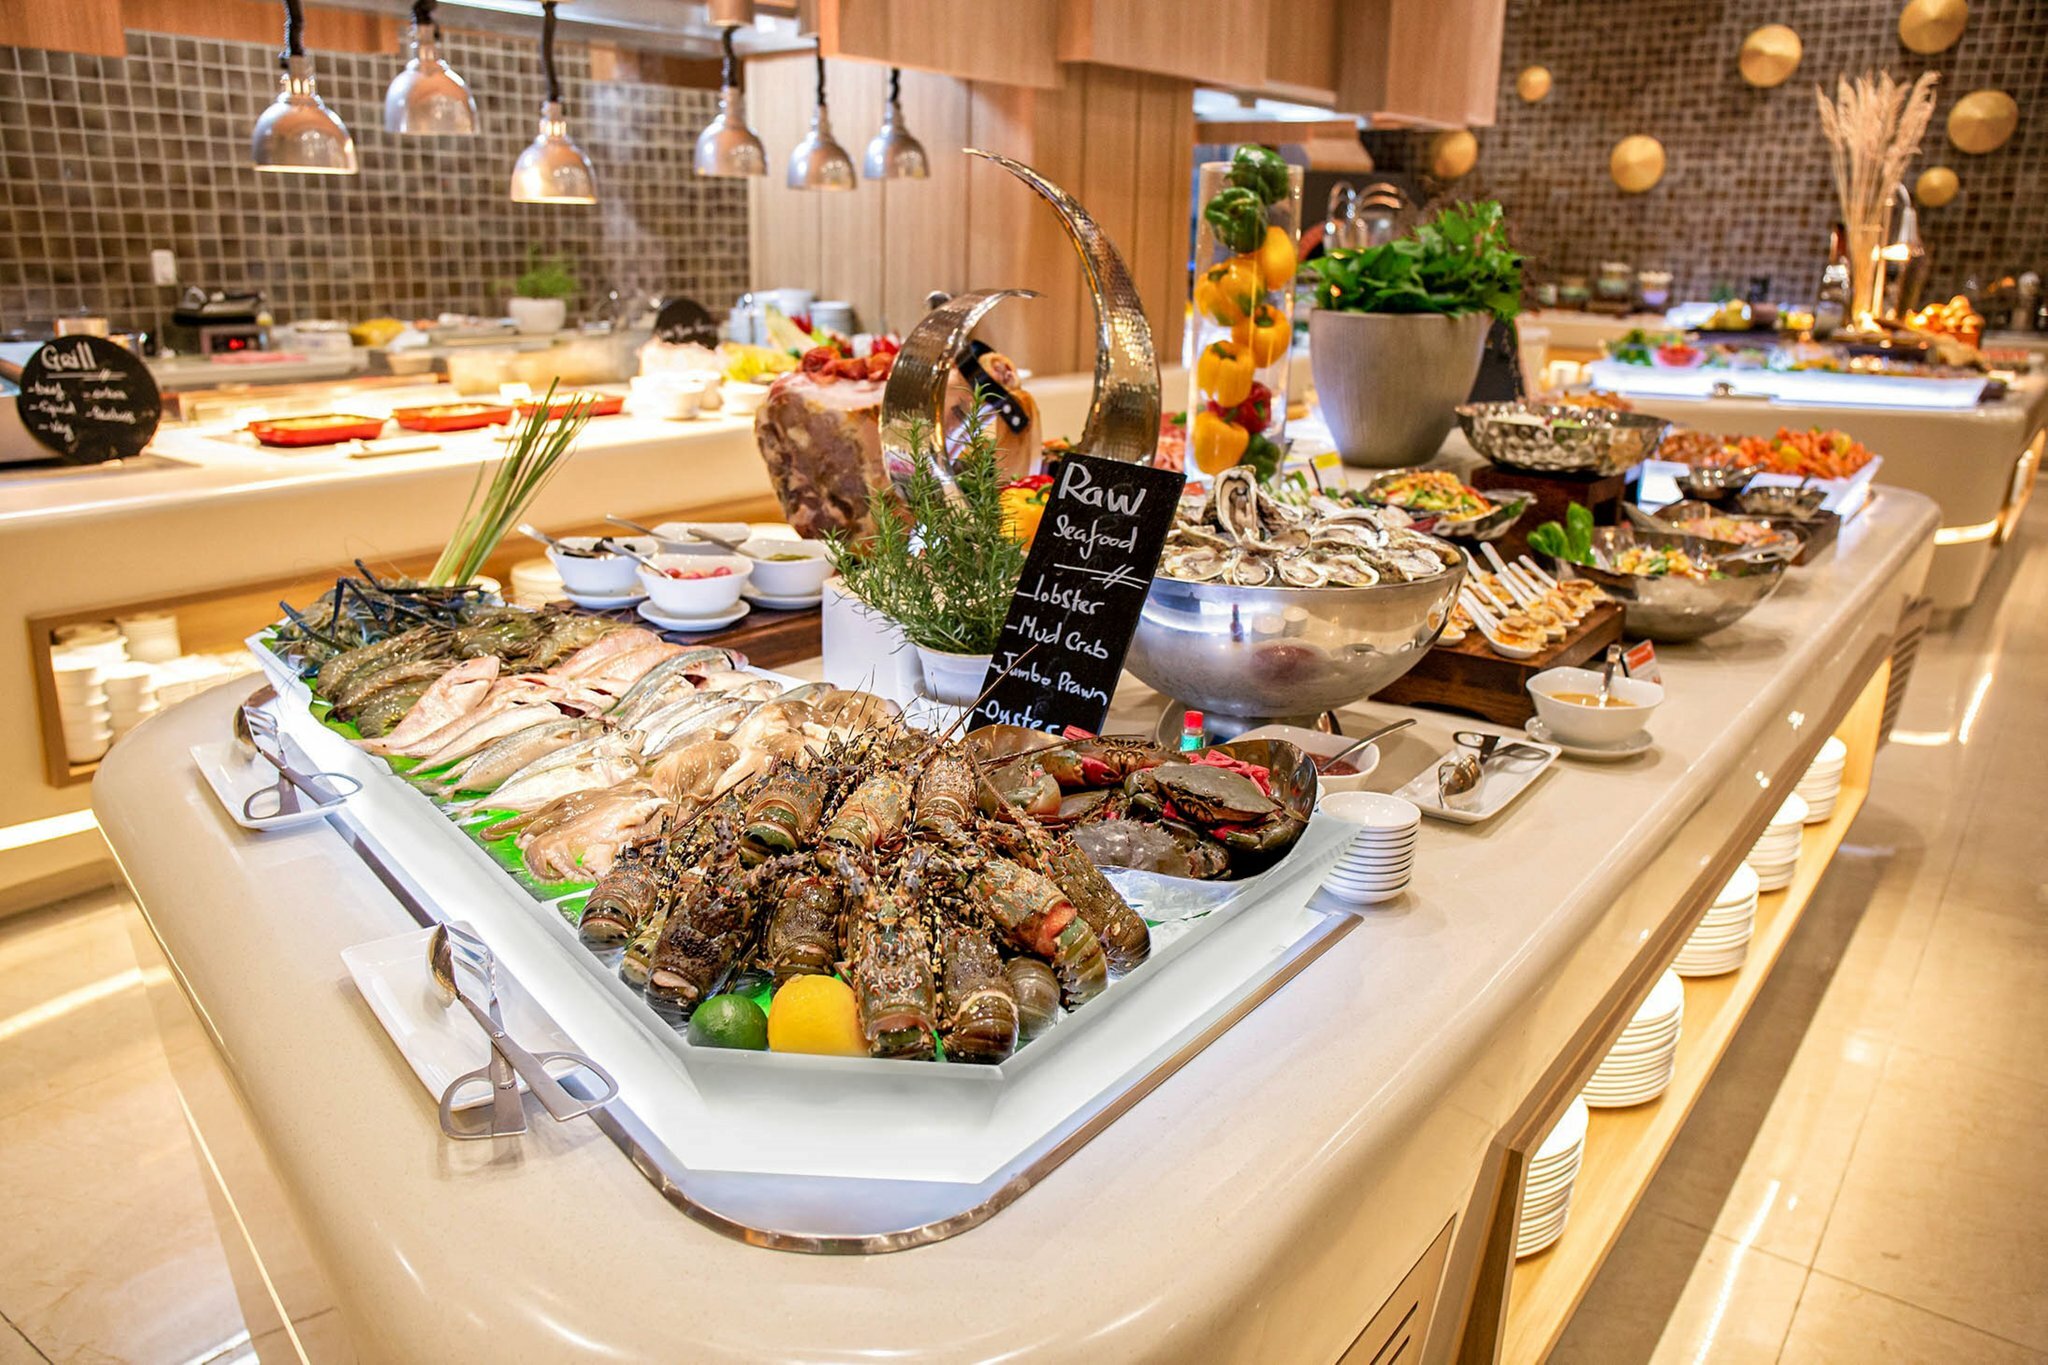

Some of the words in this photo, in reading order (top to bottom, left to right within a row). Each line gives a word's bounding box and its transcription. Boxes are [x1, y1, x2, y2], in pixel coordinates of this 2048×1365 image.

[1058, 462, 1147, 516] Raw
[1053, 514, 1138, 560] Seafood
[1065, 631, 1109, 659] Crab
[1058, 671, 1108, 706] Prawn
